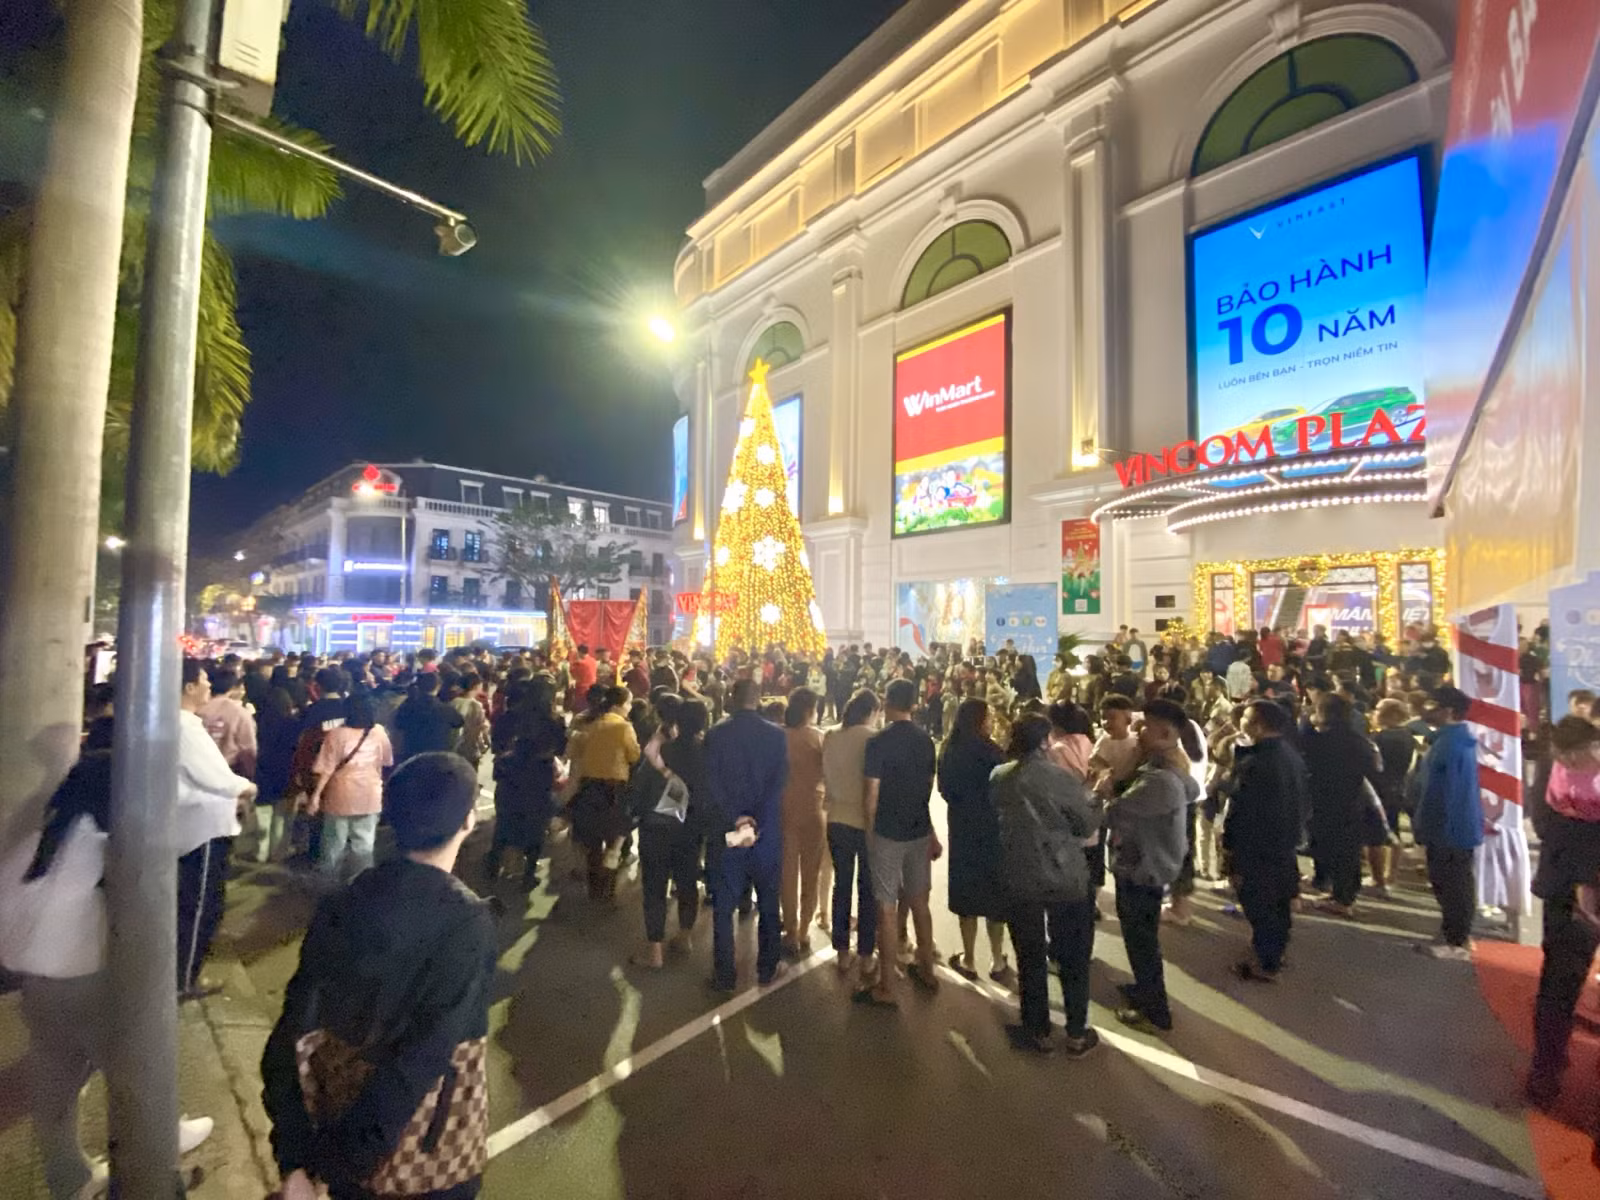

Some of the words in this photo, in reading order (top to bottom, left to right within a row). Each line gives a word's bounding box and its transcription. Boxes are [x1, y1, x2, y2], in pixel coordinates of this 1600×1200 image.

[1217, 282, 1280, 315] BẢO
[1290, 244, 1392, 293] HÀNH
[1218, 303, 1302, 365] 10
[1318, 304, 1396, 342] NĂM
[1377, 341, 1398, 353] TIN
[903, 375, 983, 417] WinMart
[1115, 424, 1280, 489] VINCOM
